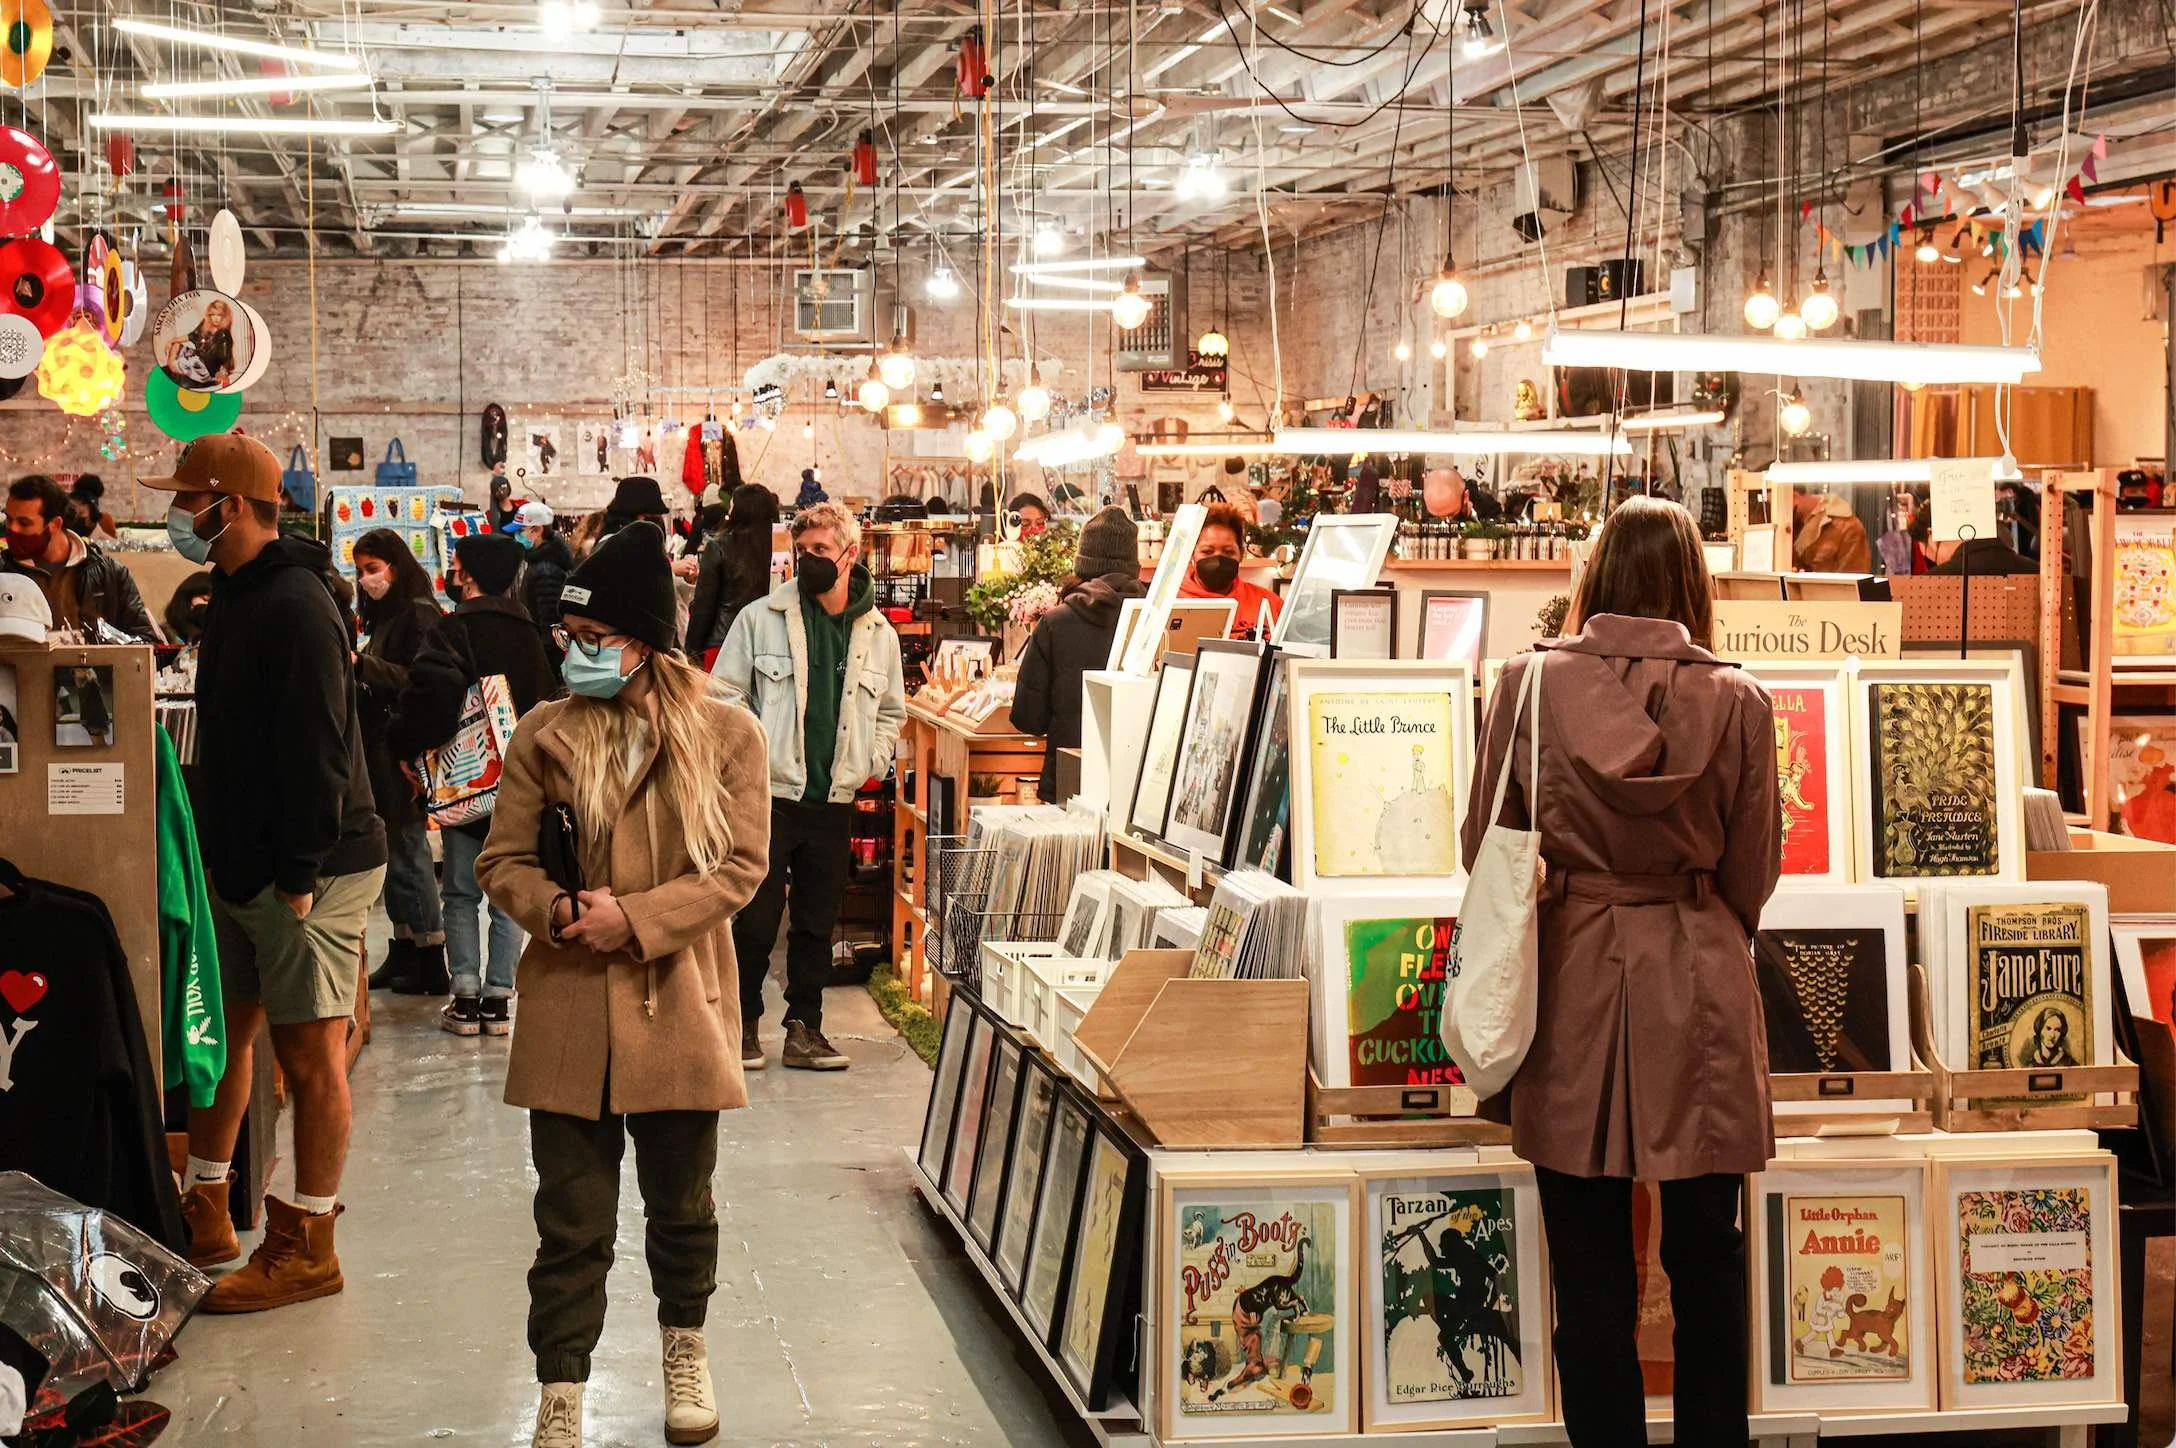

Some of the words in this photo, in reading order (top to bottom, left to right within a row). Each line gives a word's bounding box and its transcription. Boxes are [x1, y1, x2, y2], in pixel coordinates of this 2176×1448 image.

[1788, 614, 1808, 628] The
[1713, 618, 1809, 654] Curious
[1819, 620, 1888, 655] Desk
[1321, 715, 1346, 735] The
[1349, 716, 1386, 736] Little
[1390, 715, 1437, 735] Prince
[1931, 794, 1968, 807] PRIDE
[1920, 811, 1982, 823] PREJUDICE
[1926, 831, 1944, 842] Jane
[1945, 831, 1979, 841] Austen
[1982, 921, 2028, 941] FIRESIDE
[1996, 917, 2037, 926] THOMPSON
[1981, 950, 2037, 1012] Jane
[2039, 949, 2081, 996] Eyre
[1386, 1197, 1448, 1226] Tarzan
[1800, 1207, 1830, 1221] Little
[1831, 1207, 1879, 1226] Orphan
[1474, 1216, 1513, 1242] Apes
[1798, 1228, 1881, 1255] Annie
[1225, 1241, 1241, 1264] in
[1396, 1384, 1426, 1397] Edgar
[1430, 1382, 1454, 1393] Rice
